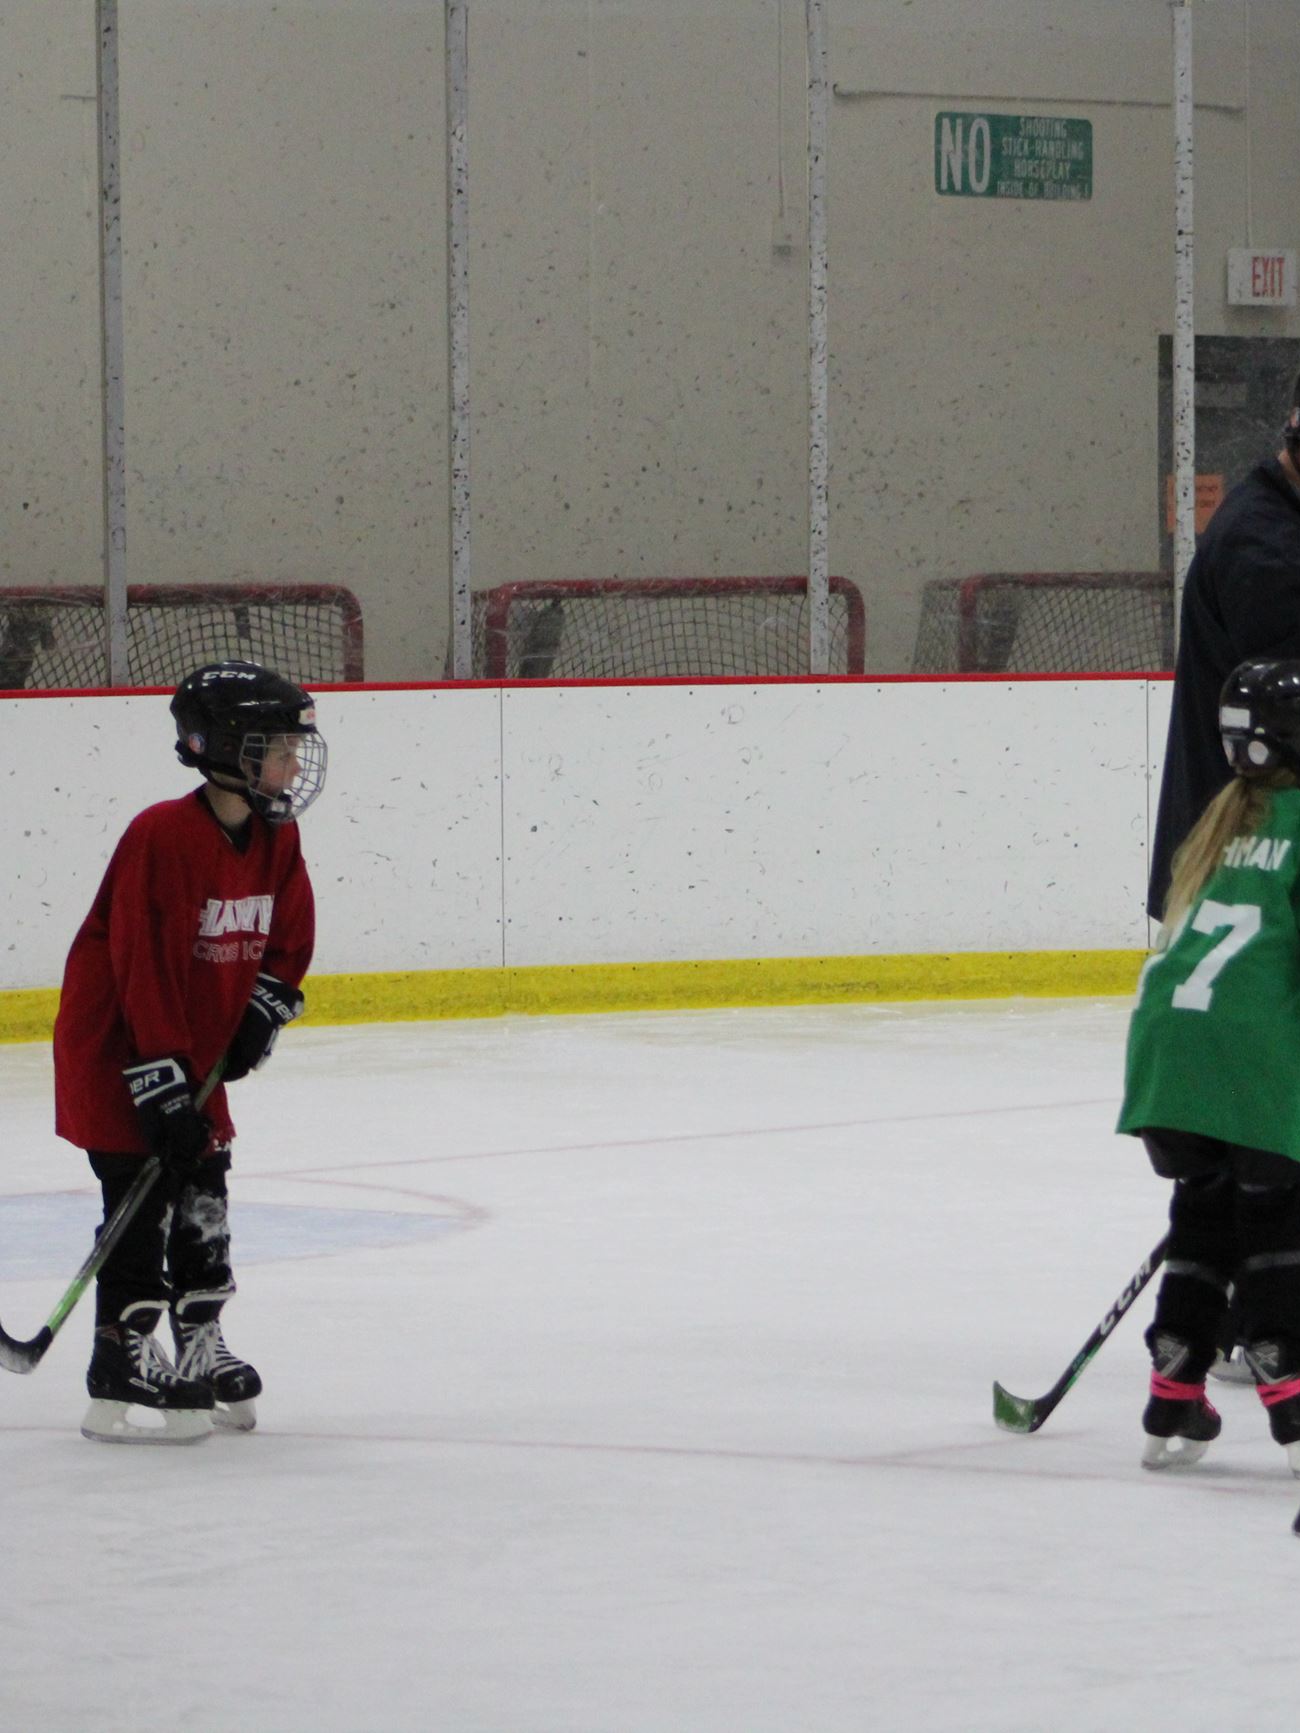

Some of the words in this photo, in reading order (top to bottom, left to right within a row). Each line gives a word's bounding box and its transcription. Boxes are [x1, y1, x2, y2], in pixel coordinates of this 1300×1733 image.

[940, 117, 991, 193] NO
[1252, 256, 1284, 297] EXIT
[1172, 900, 1261, 1012] 7
[1100, 1260, 1151, 1335] CCM
